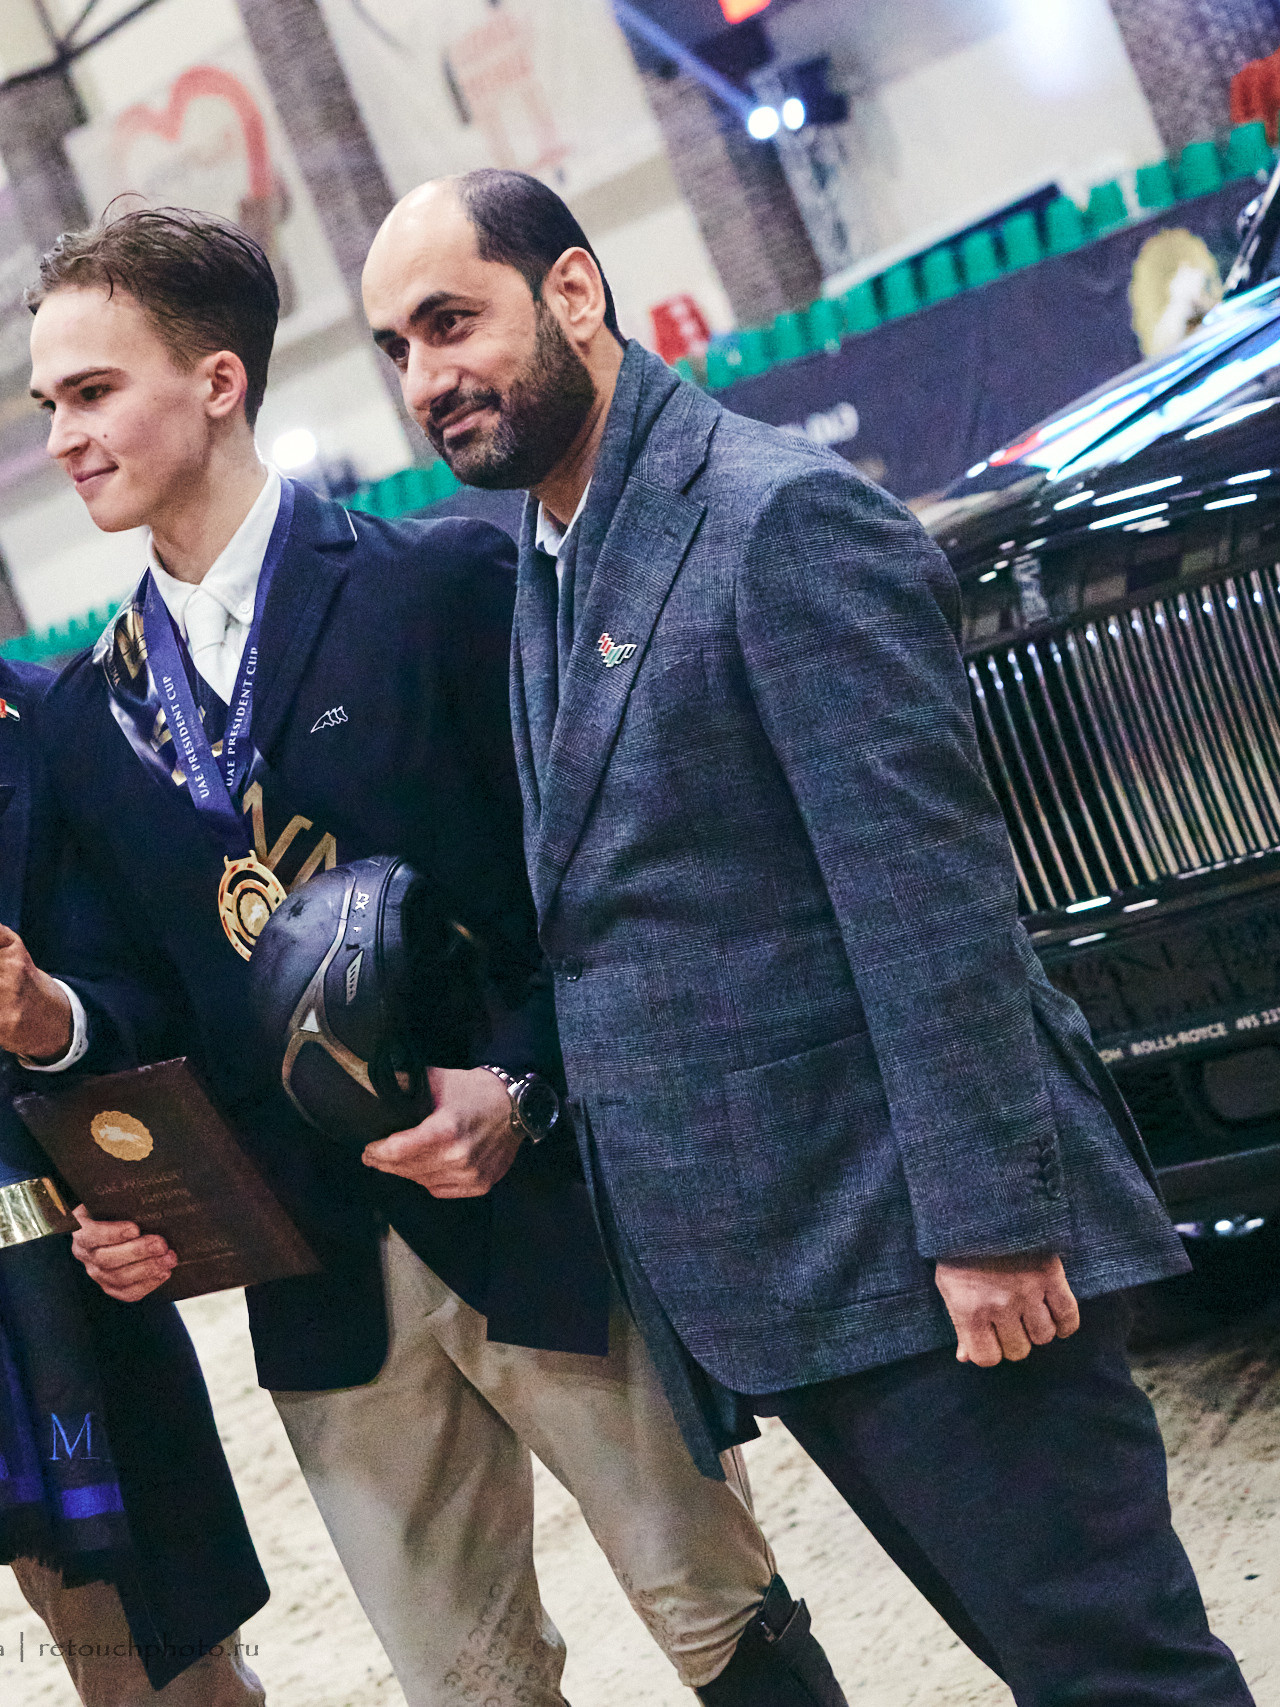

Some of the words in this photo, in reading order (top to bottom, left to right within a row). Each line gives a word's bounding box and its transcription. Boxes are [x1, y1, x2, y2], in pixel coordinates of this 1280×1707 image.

[245, 646, 259, 676] CUP
[162, 675, 177, 702] CUP
[228, 680, 254, 755] PRESIDENT
[170, 702, 202, 773] PRESIDENT
[193, 773, 210, 799] UAE
[226, 761, 236, 787] UAE
